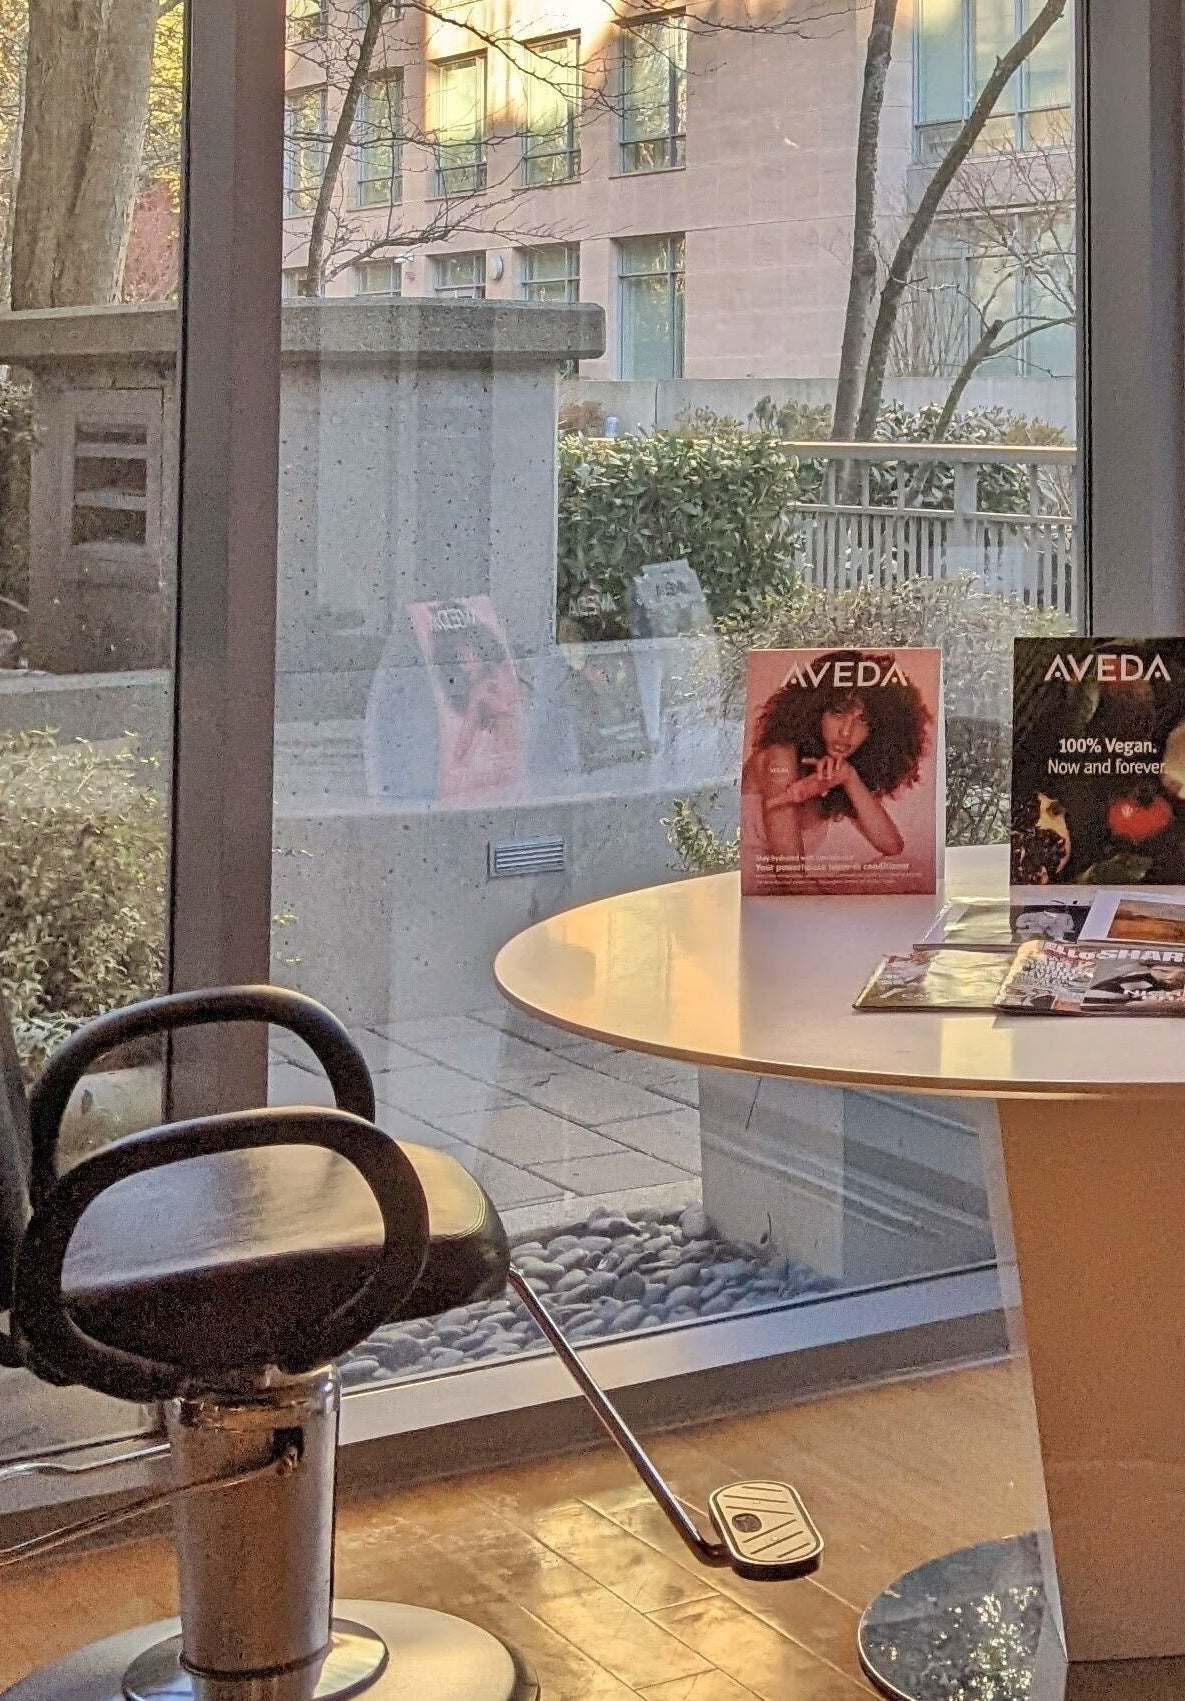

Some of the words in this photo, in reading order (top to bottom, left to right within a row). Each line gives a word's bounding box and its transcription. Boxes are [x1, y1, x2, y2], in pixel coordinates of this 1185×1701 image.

[780, 660, 909, 688] AVEDA
[1043, 653, 1172, 682] AVEDA
[1058, 737, 1102, 754] 100%
[1105, 737, 1158, 757] Vegan.
[1047, 759, 1081, 775] Now
[1083, 759, 1111, 775] and
